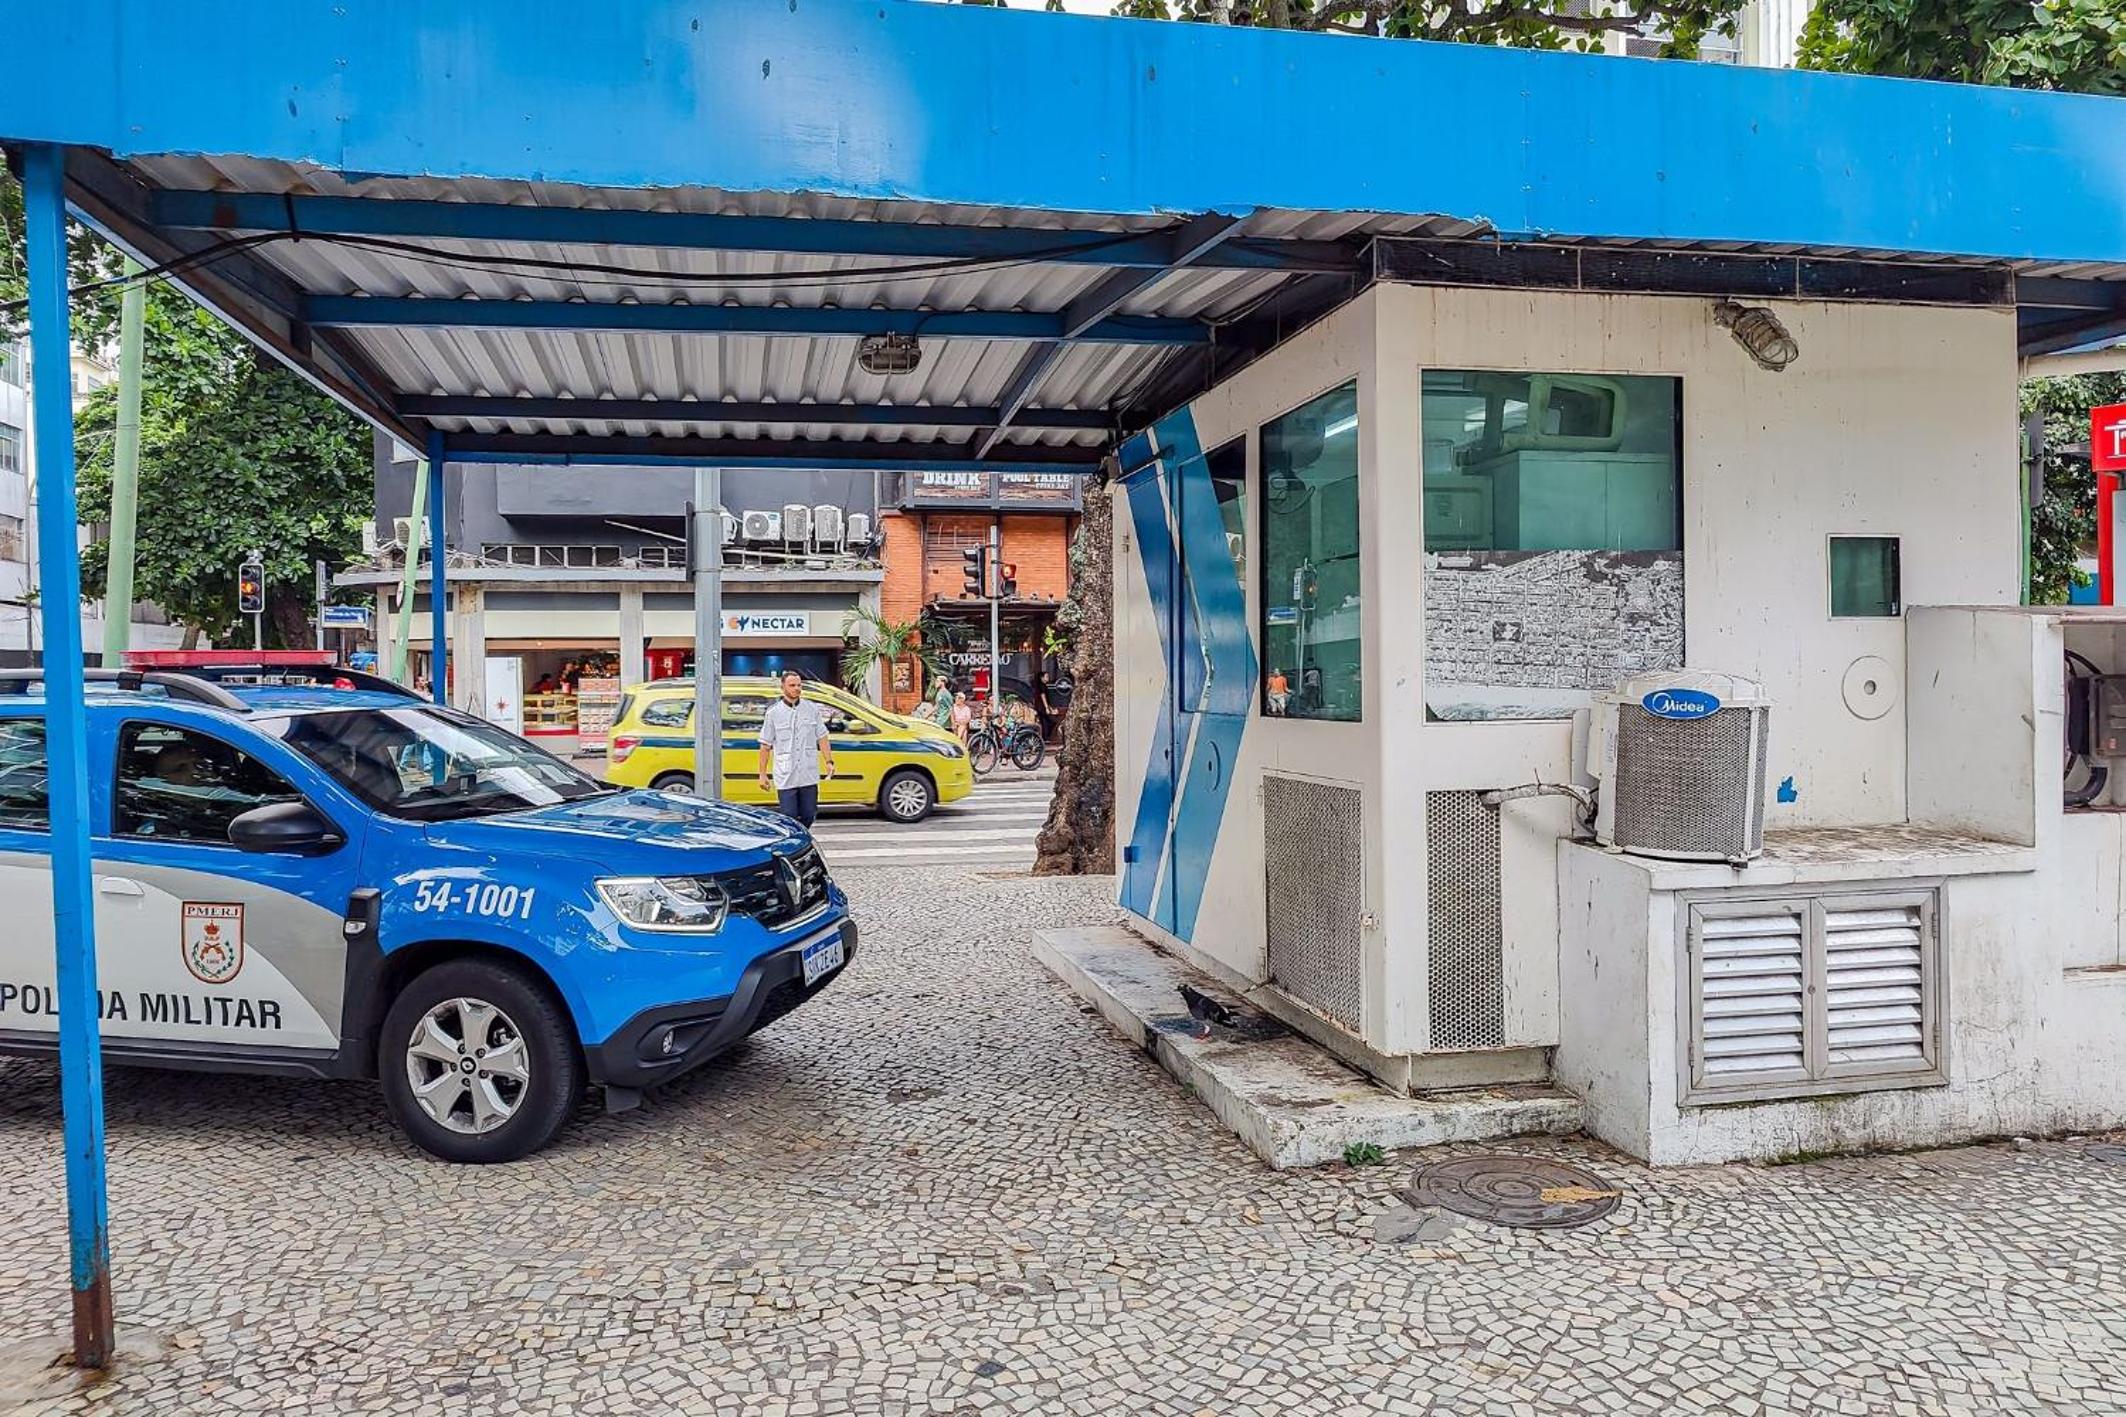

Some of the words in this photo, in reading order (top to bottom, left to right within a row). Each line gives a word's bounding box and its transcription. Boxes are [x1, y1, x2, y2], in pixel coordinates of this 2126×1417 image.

[922, 472, 981, 485] DRINK
[751, 618, 805, 630] NECTAR
[949, 652, 1010, 666] CARREO
[1652, 692, 1705, 713] Midea
[414, 880, 535, 919] 54-1001
[0, 983, 127, 1021] POLIA
[139, 992, 281, 1029] MILITAR
